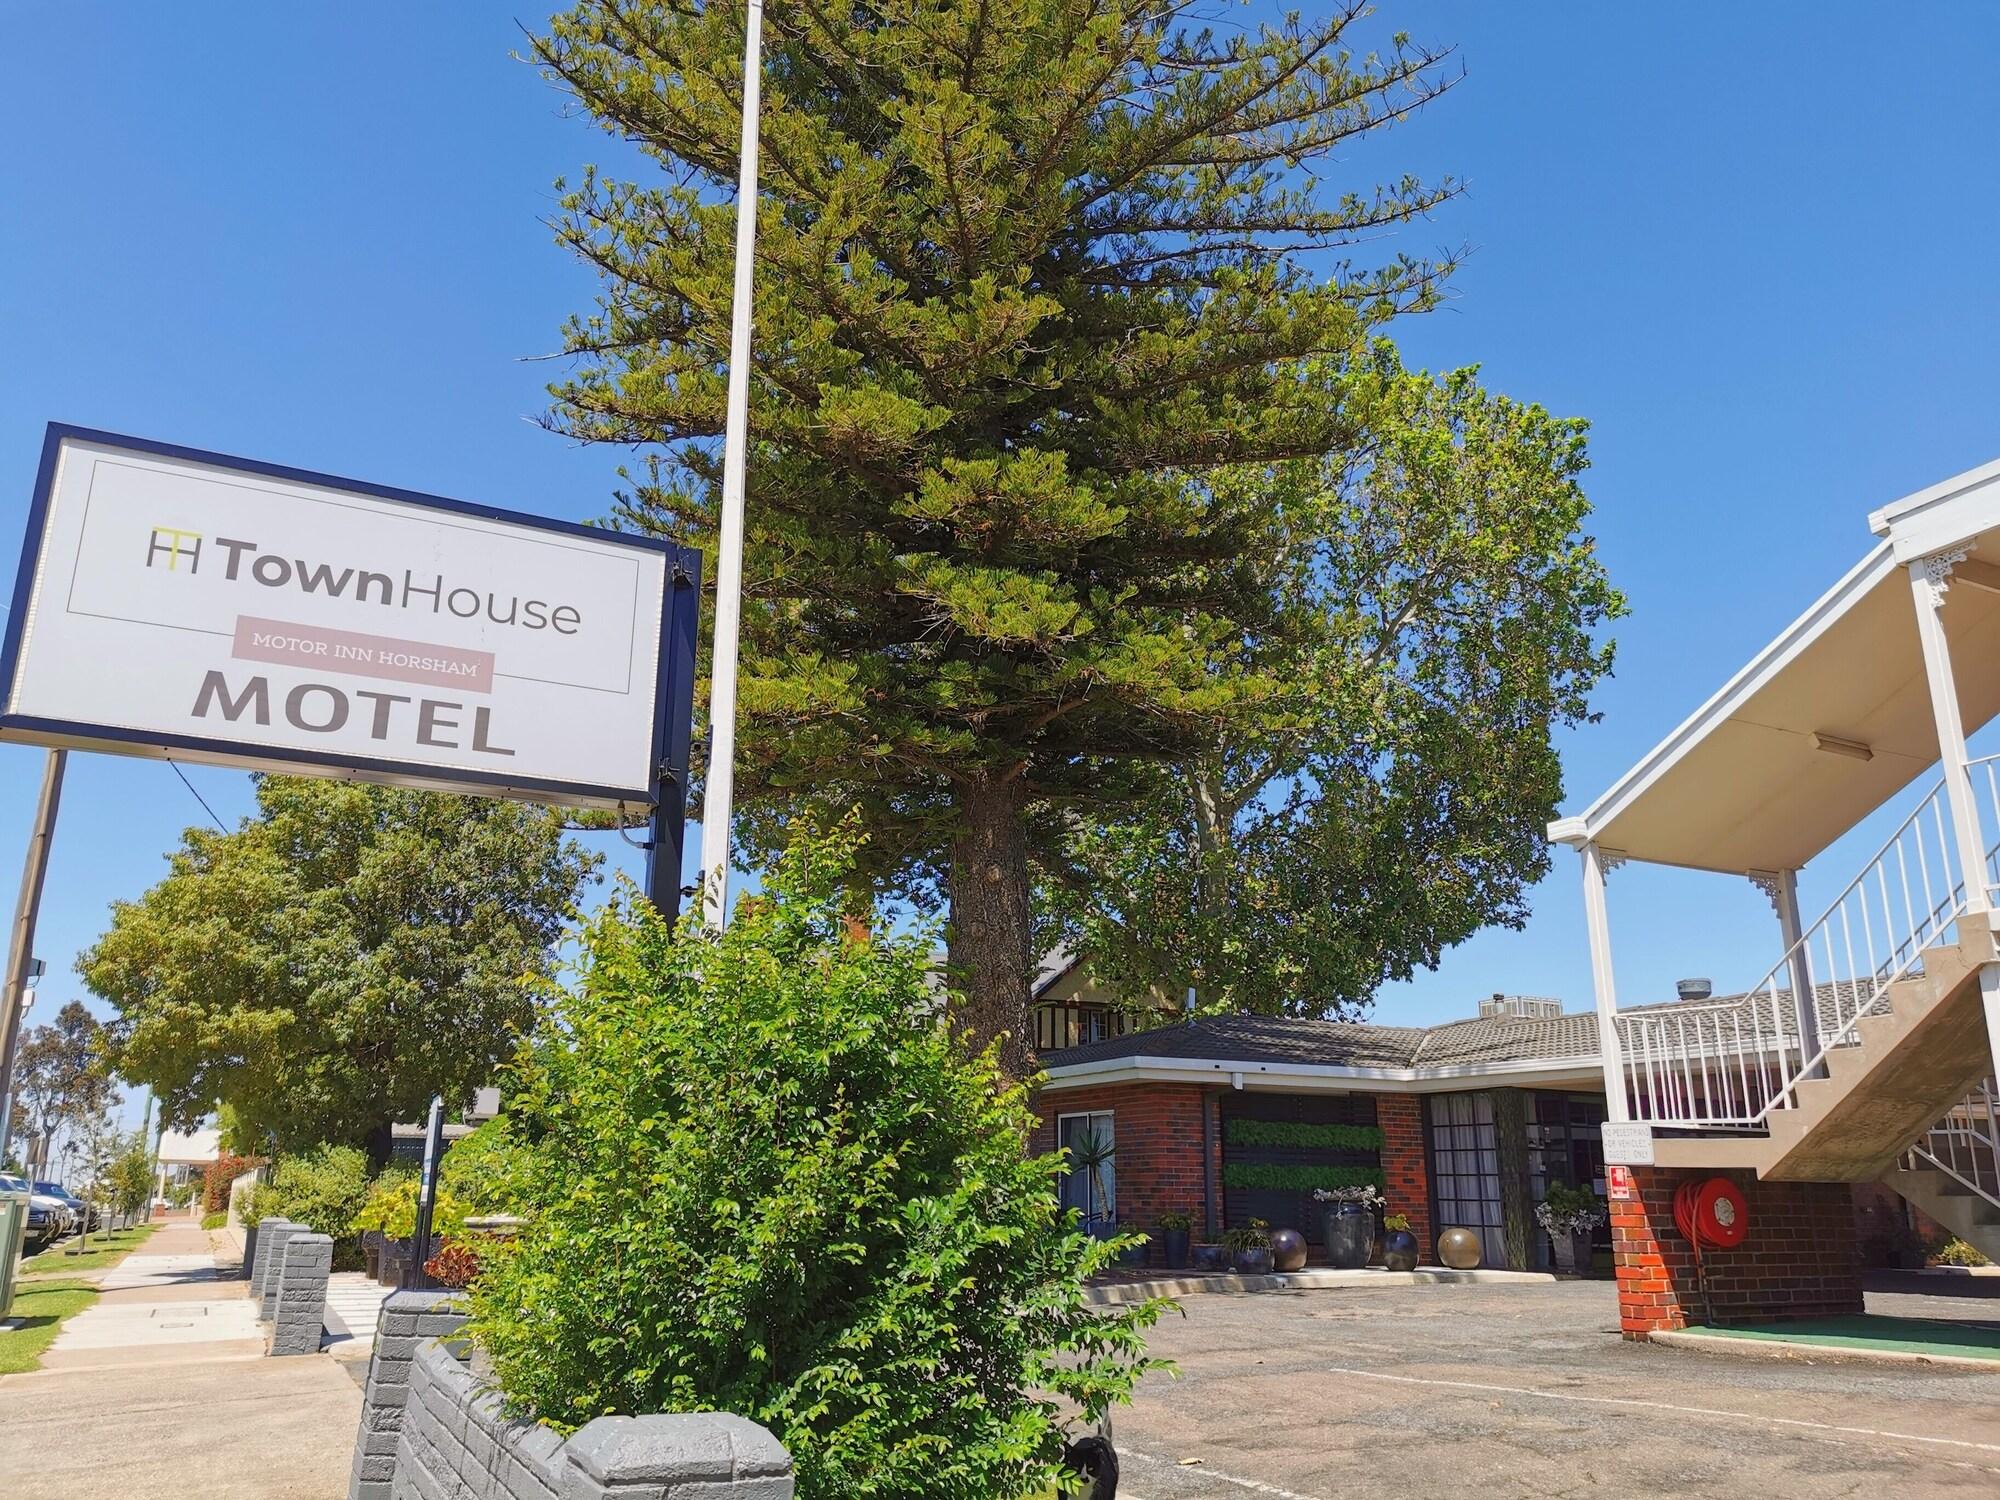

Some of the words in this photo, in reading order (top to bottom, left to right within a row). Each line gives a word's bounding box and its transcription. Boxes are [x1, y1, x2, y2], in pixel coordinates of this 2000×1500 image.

[216, 537, 581, 635] TownHouse
[252, 632, 328, 656] MOTOR
[334, 645, 374, 663] INN
[379, 651, 478, 677] HORSHAM
[191, 669, 516, 757] MOTEL
